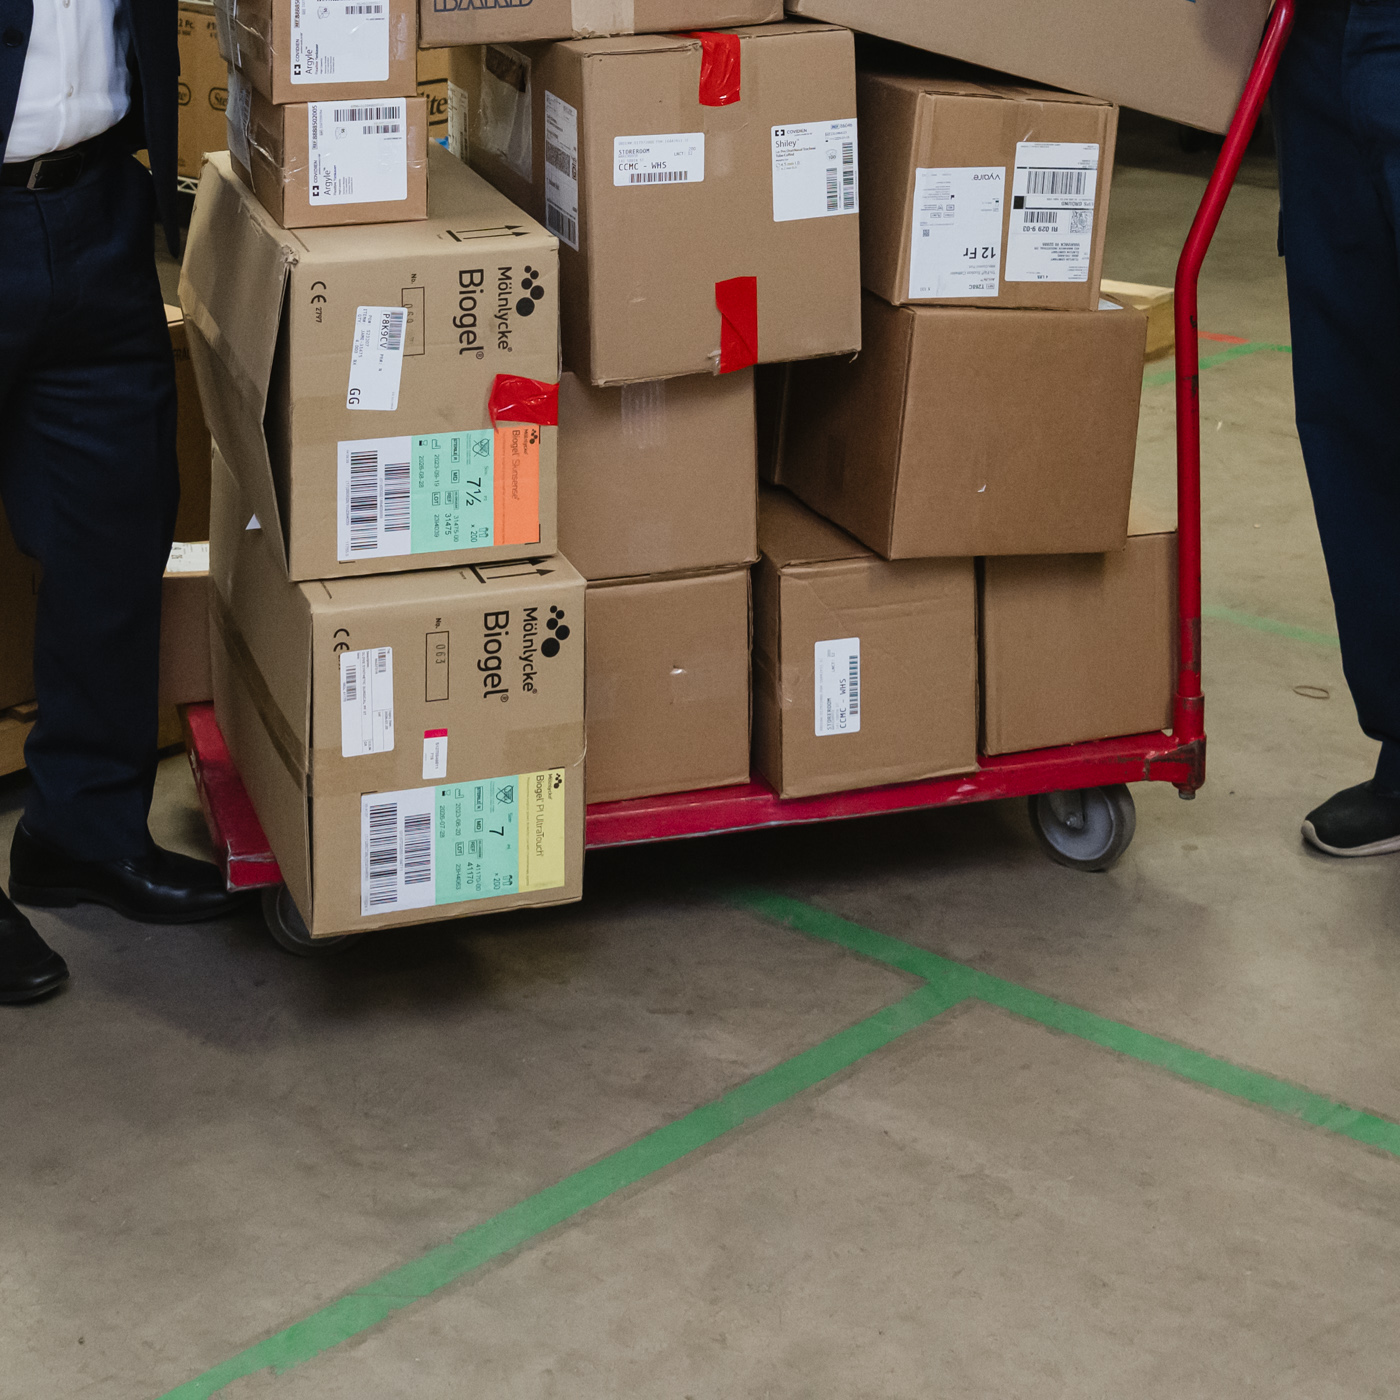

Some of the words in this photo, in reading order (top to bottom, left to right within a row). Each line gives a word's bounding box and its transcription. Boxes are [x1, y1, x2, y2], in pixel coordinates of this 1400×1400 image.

[618, 162, 639, 171] CCMC
[651, 161, 667, 169] WHS
[963, 247, 977, 259] Fr
[981, 246, 996, 259] 12
[380, 314, 390, 348] P8K9CV
[349, 388, 360, 405] GG
[453, 472, 457, 481] MD
[435, 644, 445, 664] 063
[839, 678, 847, 695] WHS
[839, 707, 847, 729] CCMC
[476, 820, 481, 830] MD
[489, 826, 504, 836] 7
